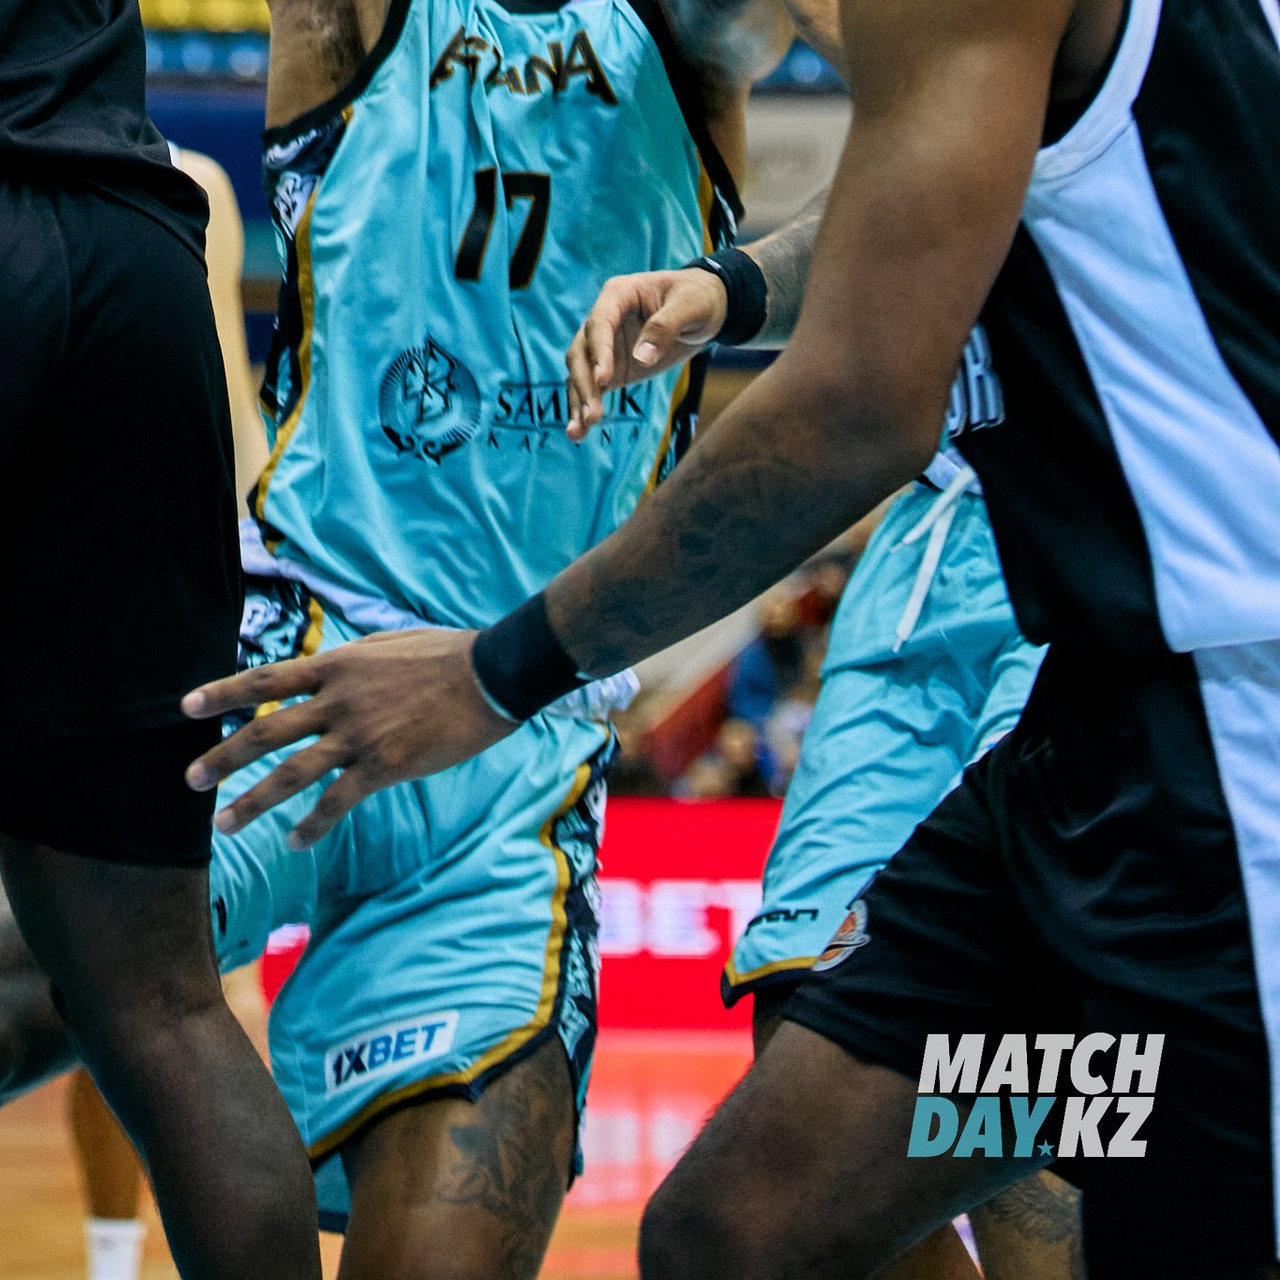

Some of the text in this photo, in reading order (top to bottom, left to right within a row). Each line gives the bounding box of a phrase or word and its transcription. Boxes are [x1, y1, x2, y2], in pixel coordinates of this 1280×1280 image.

[455, 166, 551, 290] 17
[495, 385, 645, 424] SAMK
[333, 1022, 447, 1086] 1XBET
